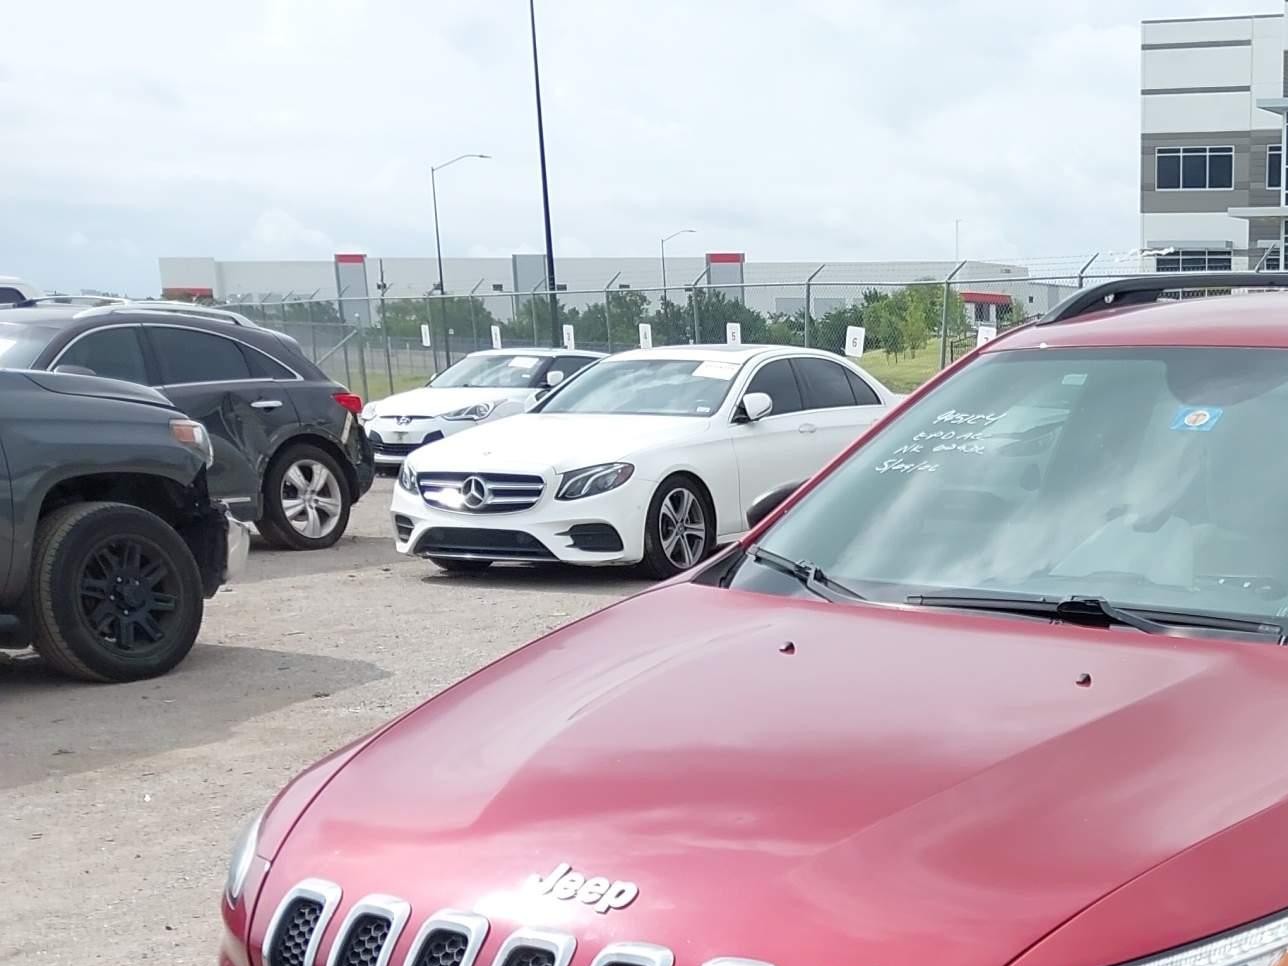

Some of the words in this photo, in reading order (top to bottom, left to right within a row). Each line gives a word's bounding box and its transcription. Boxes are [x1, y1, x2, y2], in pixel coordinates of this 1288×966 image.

[731, 331, 736, 341] 5
[851, 337, 859, 348] 6
[538, 861, 640, 914] Jeep
